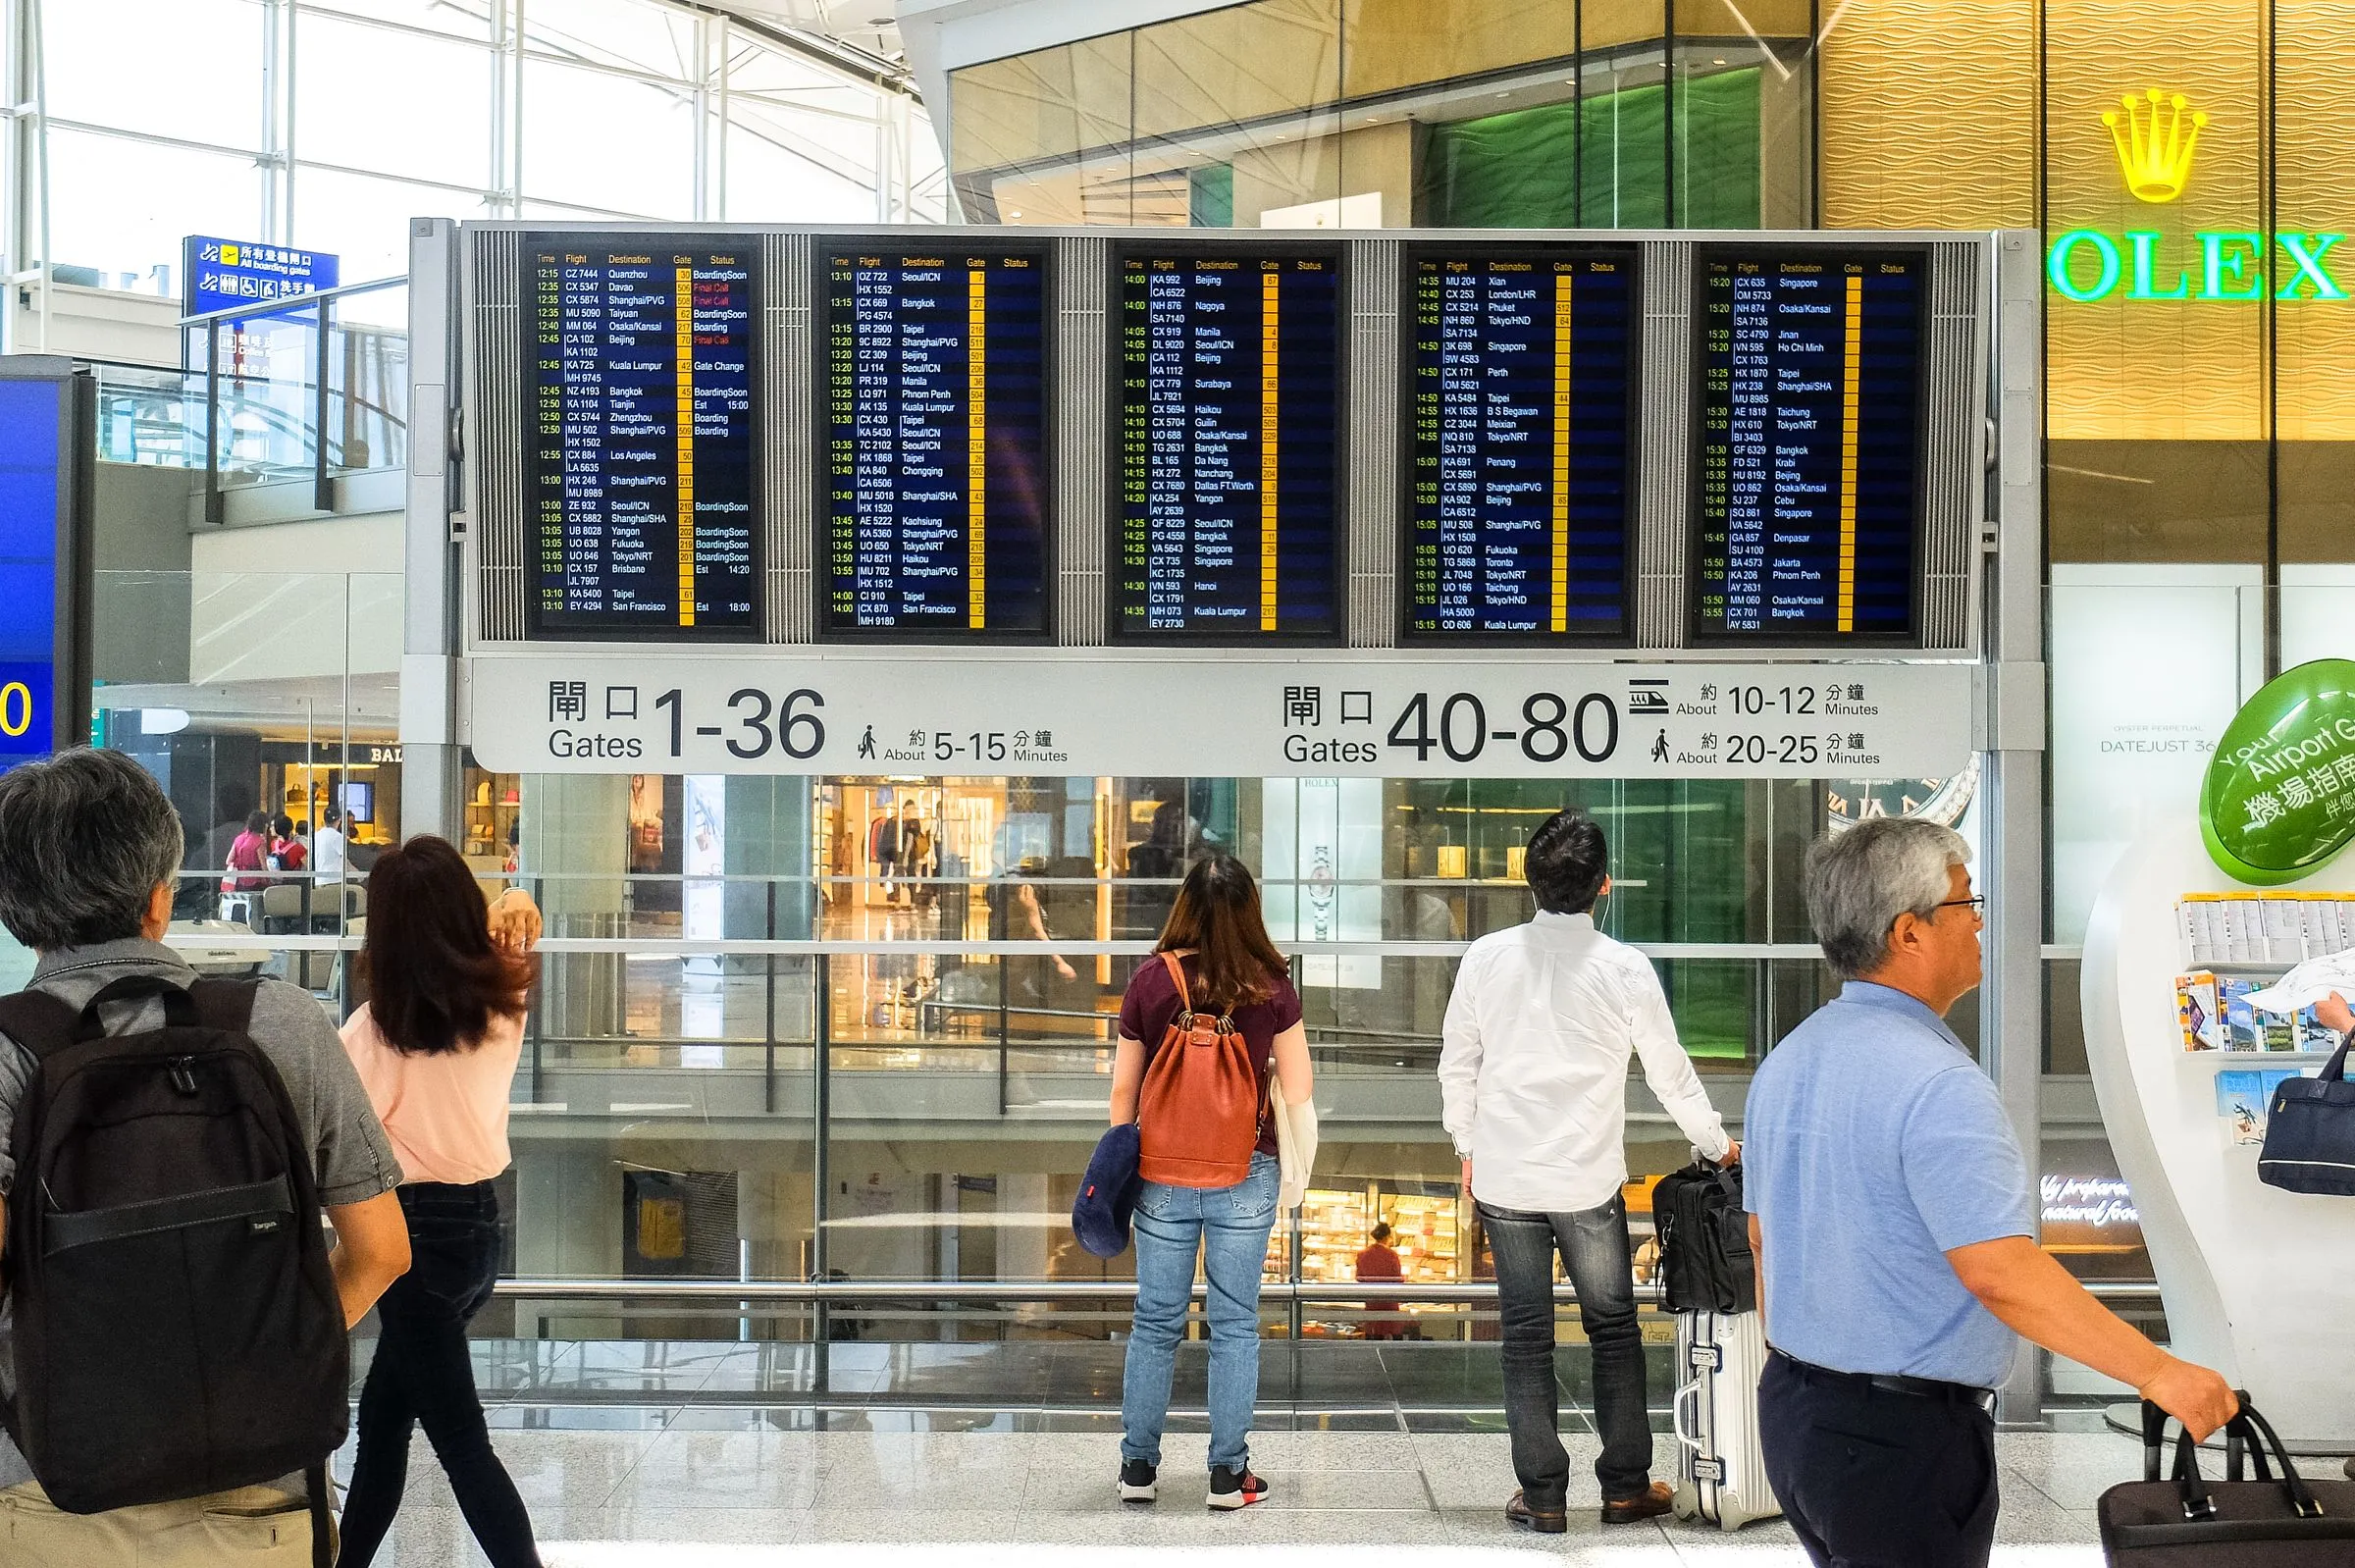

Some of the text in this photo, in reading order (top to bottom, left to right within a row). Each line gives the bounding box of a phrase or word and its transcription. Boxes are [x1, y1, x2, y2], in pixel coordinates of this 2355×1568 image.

[565, 255, 587, 264] Flight
[608, 255, 652, 264] Destination
[673, 255, 692, 264] Gate
[710, 256, 735, 265] Status
[830, 257, 1028, 268] Time Flight Destination Gate Status
[1125, 261, 1322, 271] Time Flight Destination Gate Status
[1446, 262, 1468, 272] Flight
[1489, 262, 1532, 272] Destination
[1553, 263, 1572, 272] Gate
[1591, 263, 1615, 272] Status
[2048, 230, 2349, 302] OLEX
[254, 262, 288, 275] boarding
[289, 267, 311, 276] gates
[565, 270, 579, 279] CZ
[579, 270, 598, 279] 7444
[608, 270, 648, 280] Quanzhou
[693, 271, 747, 282] BoardingSoon
[1738, 264, 1759, 274] Flight
[1780, 264, 1822, 273] Destination
[1844, 264, 1862, 274] Gate
[1880, 264, 1905, 274] Status
[902, 273, 941, 282] Seoul/ICN
[1195, 276, 1222, 286] Beijing
[1418, 277, 1439, 286] 14:35
[1489, 278, 1506, 287] Xian
[1709, 279, 1818, 288] 15:20 CX 635 Singapore
[1418, 303, 1439, 312] 14:45
[1445, 303, 1458, 312] CX
[1459, 303, 1479, 312] 5214
[1488, 303, 1515, 312] Phuket
[1736, 330, 1749, 339] SC
[1750, 330, 1769, 339] 4790
[1778, 331, 1799, 340] Jinan
[831, 338, 852, 346] 13:20
[859, 338, 870, 346] 9C
[871, 338, 891, 346] 8922
[902, 338, 958, 347] Shanghai/PVG
[567, 400, 579, 409] KA
[580, 400, 599, 409] 1104
[610, 400, 635, 410] Tianjin
[1705, 458, 1796, 467] 15:35 FD 521 Krabi
[1152, 469, 1164, 478] HX
[1166, 469, 1180, 478] 272
[1194, 470, 1233, 479] Nanchang
[1703, 558, 1801, 567] 15:50 BA 4573 Jakarta
[1124, 582, 1217, 591] 14:30 VN 593 Hanoi
[1415, 583, 1519, 594] 15:10 UO 166 Taichung
[832, 592, 853, 601] 14:00
[860, 592, 868, 601] CI
[870, 592, 885, 601] 910
[903, 592, 924, 601] Taipei
[612, 602, 628, 611] San
[630, 602, 666, 611] Francisco
[1701, 683, 1717, 702] 約
[1825, 683, 1864, 703] 分鐘
[550, 681, 638, 723] 閘口
[1282, 685, 1373, 728] 閘口
[1727, 685, 1816, 716] 10-12
[1676, 702, 1718, 716] About
[1825, 702, 1878, 716] Minutes
[654, 688, 826, 761] 1-36
[1387, 691, 1619, 765] 40-80
[548, 729, 644, 759] Gates
[909, 729, 926, 748] 約
[1014, 729, 1053, 749] 分鐘
[1701, 731, 1718, 750] 約
[1826, 732, 1864, 751] 分鐘
[934, 731, 1007, 761] 5-15
[1282, 733, 1379, 764] Gates
[1725, 733, 1819, 765] 20-25
[2101, 741, 2216, 753] DATEJUST 36
[2247, 718, 2355, 783] Airport G
[371, 748, 403, 762] BAL
[884, 747, 925, 762] About
[1014, 748, 1068, 762] Minutes
[1676, 750, 1718, 764] About
[1826, 750, 1880, 764] Minutes
[2326, 789, 2355, 819] 伴您
